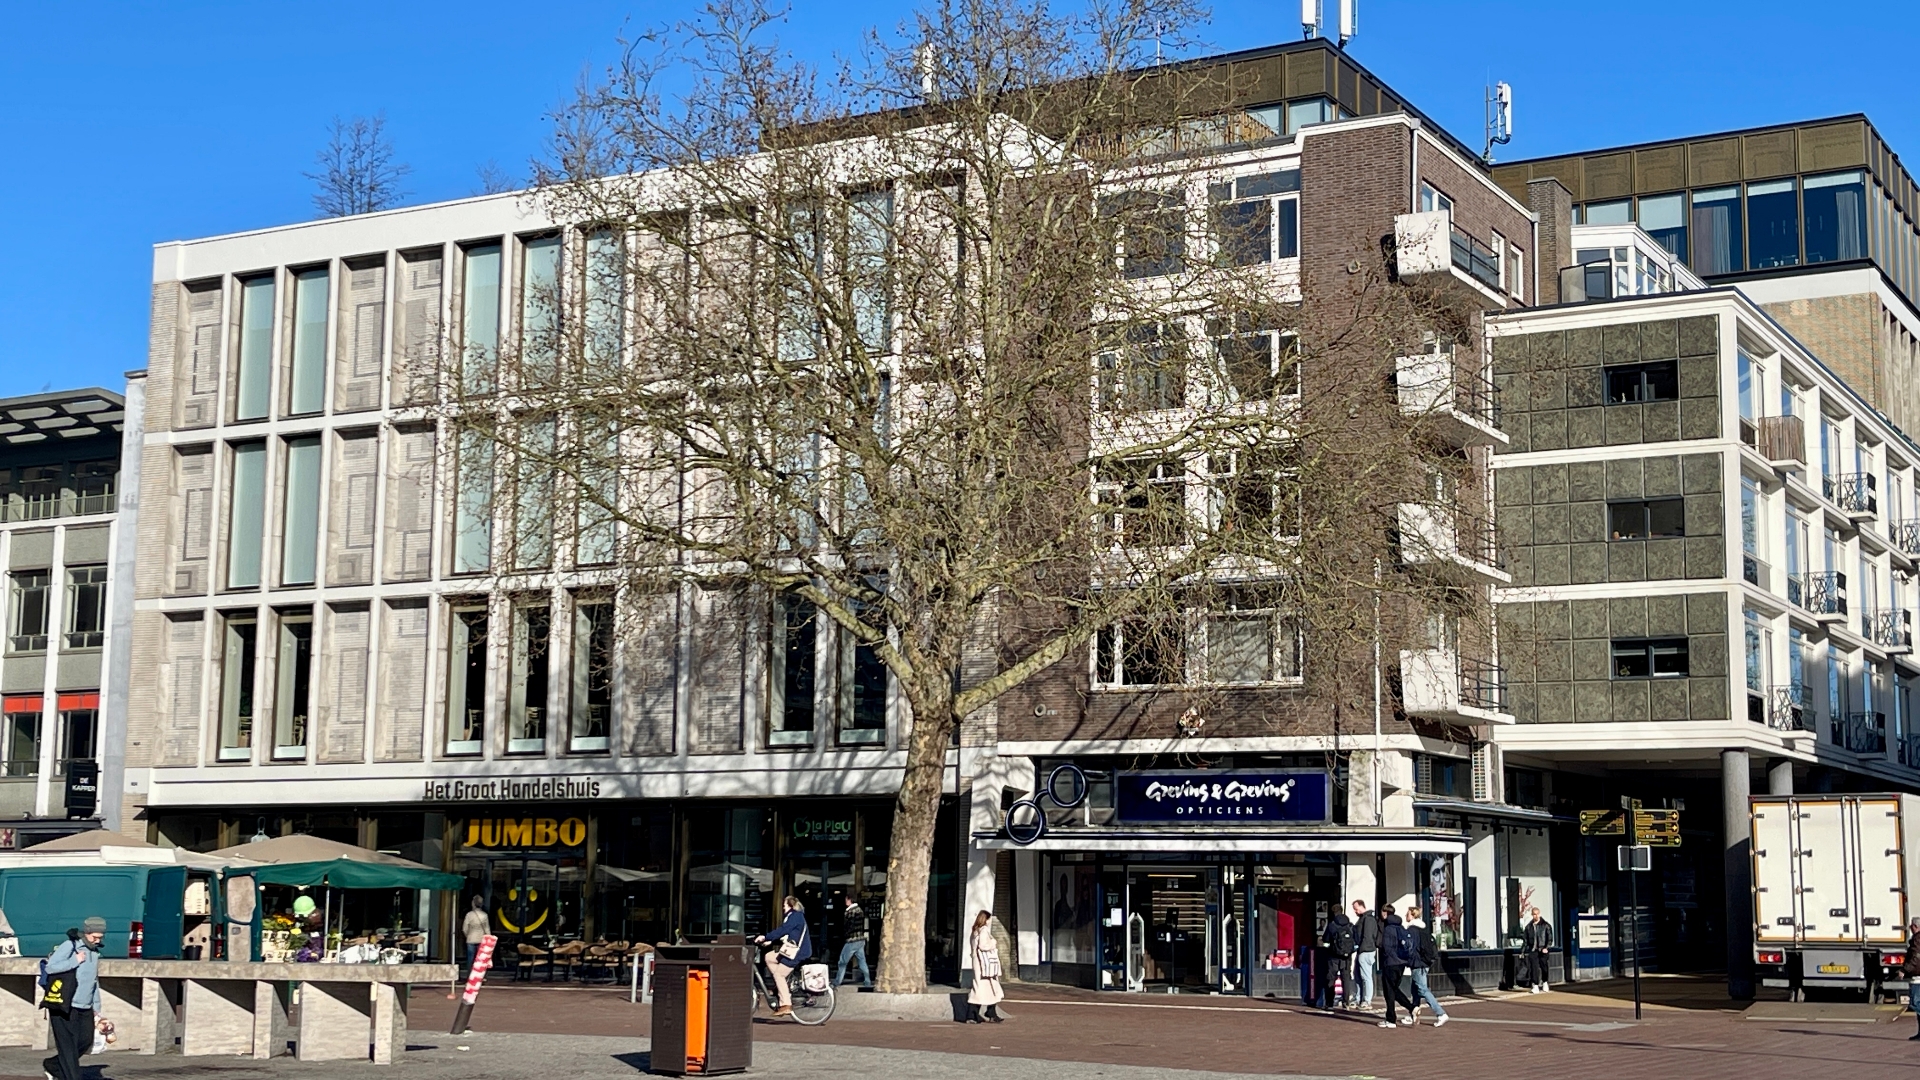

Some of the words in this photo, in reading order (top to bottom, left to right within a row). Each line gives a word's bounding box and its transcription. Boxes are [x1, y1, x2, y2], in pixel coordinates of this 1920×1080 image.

[425, 780, 450, 799] Het
[455, 780, 497, 799] Groot
[501, 777, 600, 798] Handelshuis
[1145, 780, 1209, 803] Greving
[1211, 783, 1223, 800] &
[1176, 806, 1264, 815] OPTICIENS
[463, 817, 586, 847] JUMBO
[812, 820, 822, 833] La
